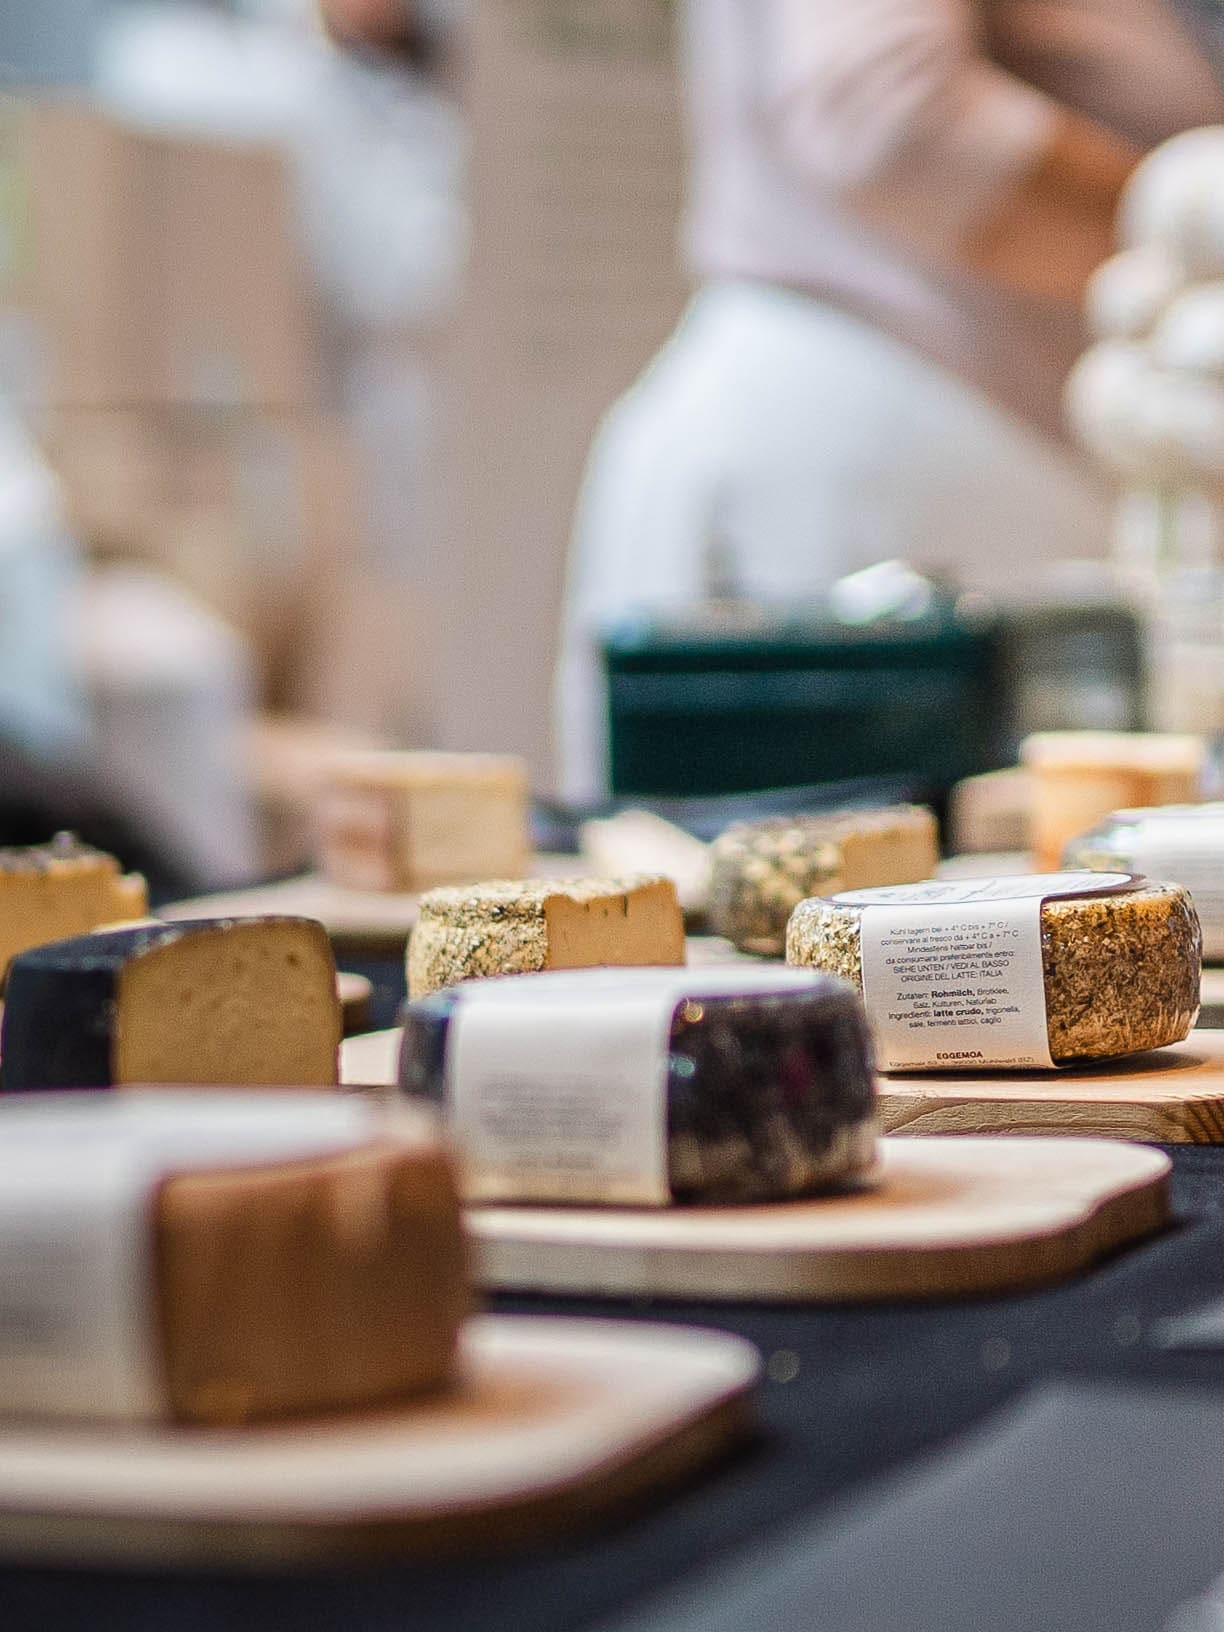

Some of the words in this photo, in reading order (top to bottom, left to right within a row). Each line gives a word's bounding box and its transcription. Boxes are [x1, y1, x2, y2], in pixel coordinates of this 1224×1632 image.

[917, 963, 945, 972] UNTEN
[950, 962, 969, 970] VEDI
[969, 961, 980, 969] AL
[981, 959, 1010, 968] BASSO
[901, 974, 934, 983] ORIGINE
[934, 972, 950, 981] DEL
[979, 969, 1003, 977] ITALIA
[931, 988, 976, 999] Rohmilch,
[933, 1009, 954, 1017] latte
[955, 1007, 984, 1016] crudo,
[936, 1050, 984, 1060] EGGEMOA
